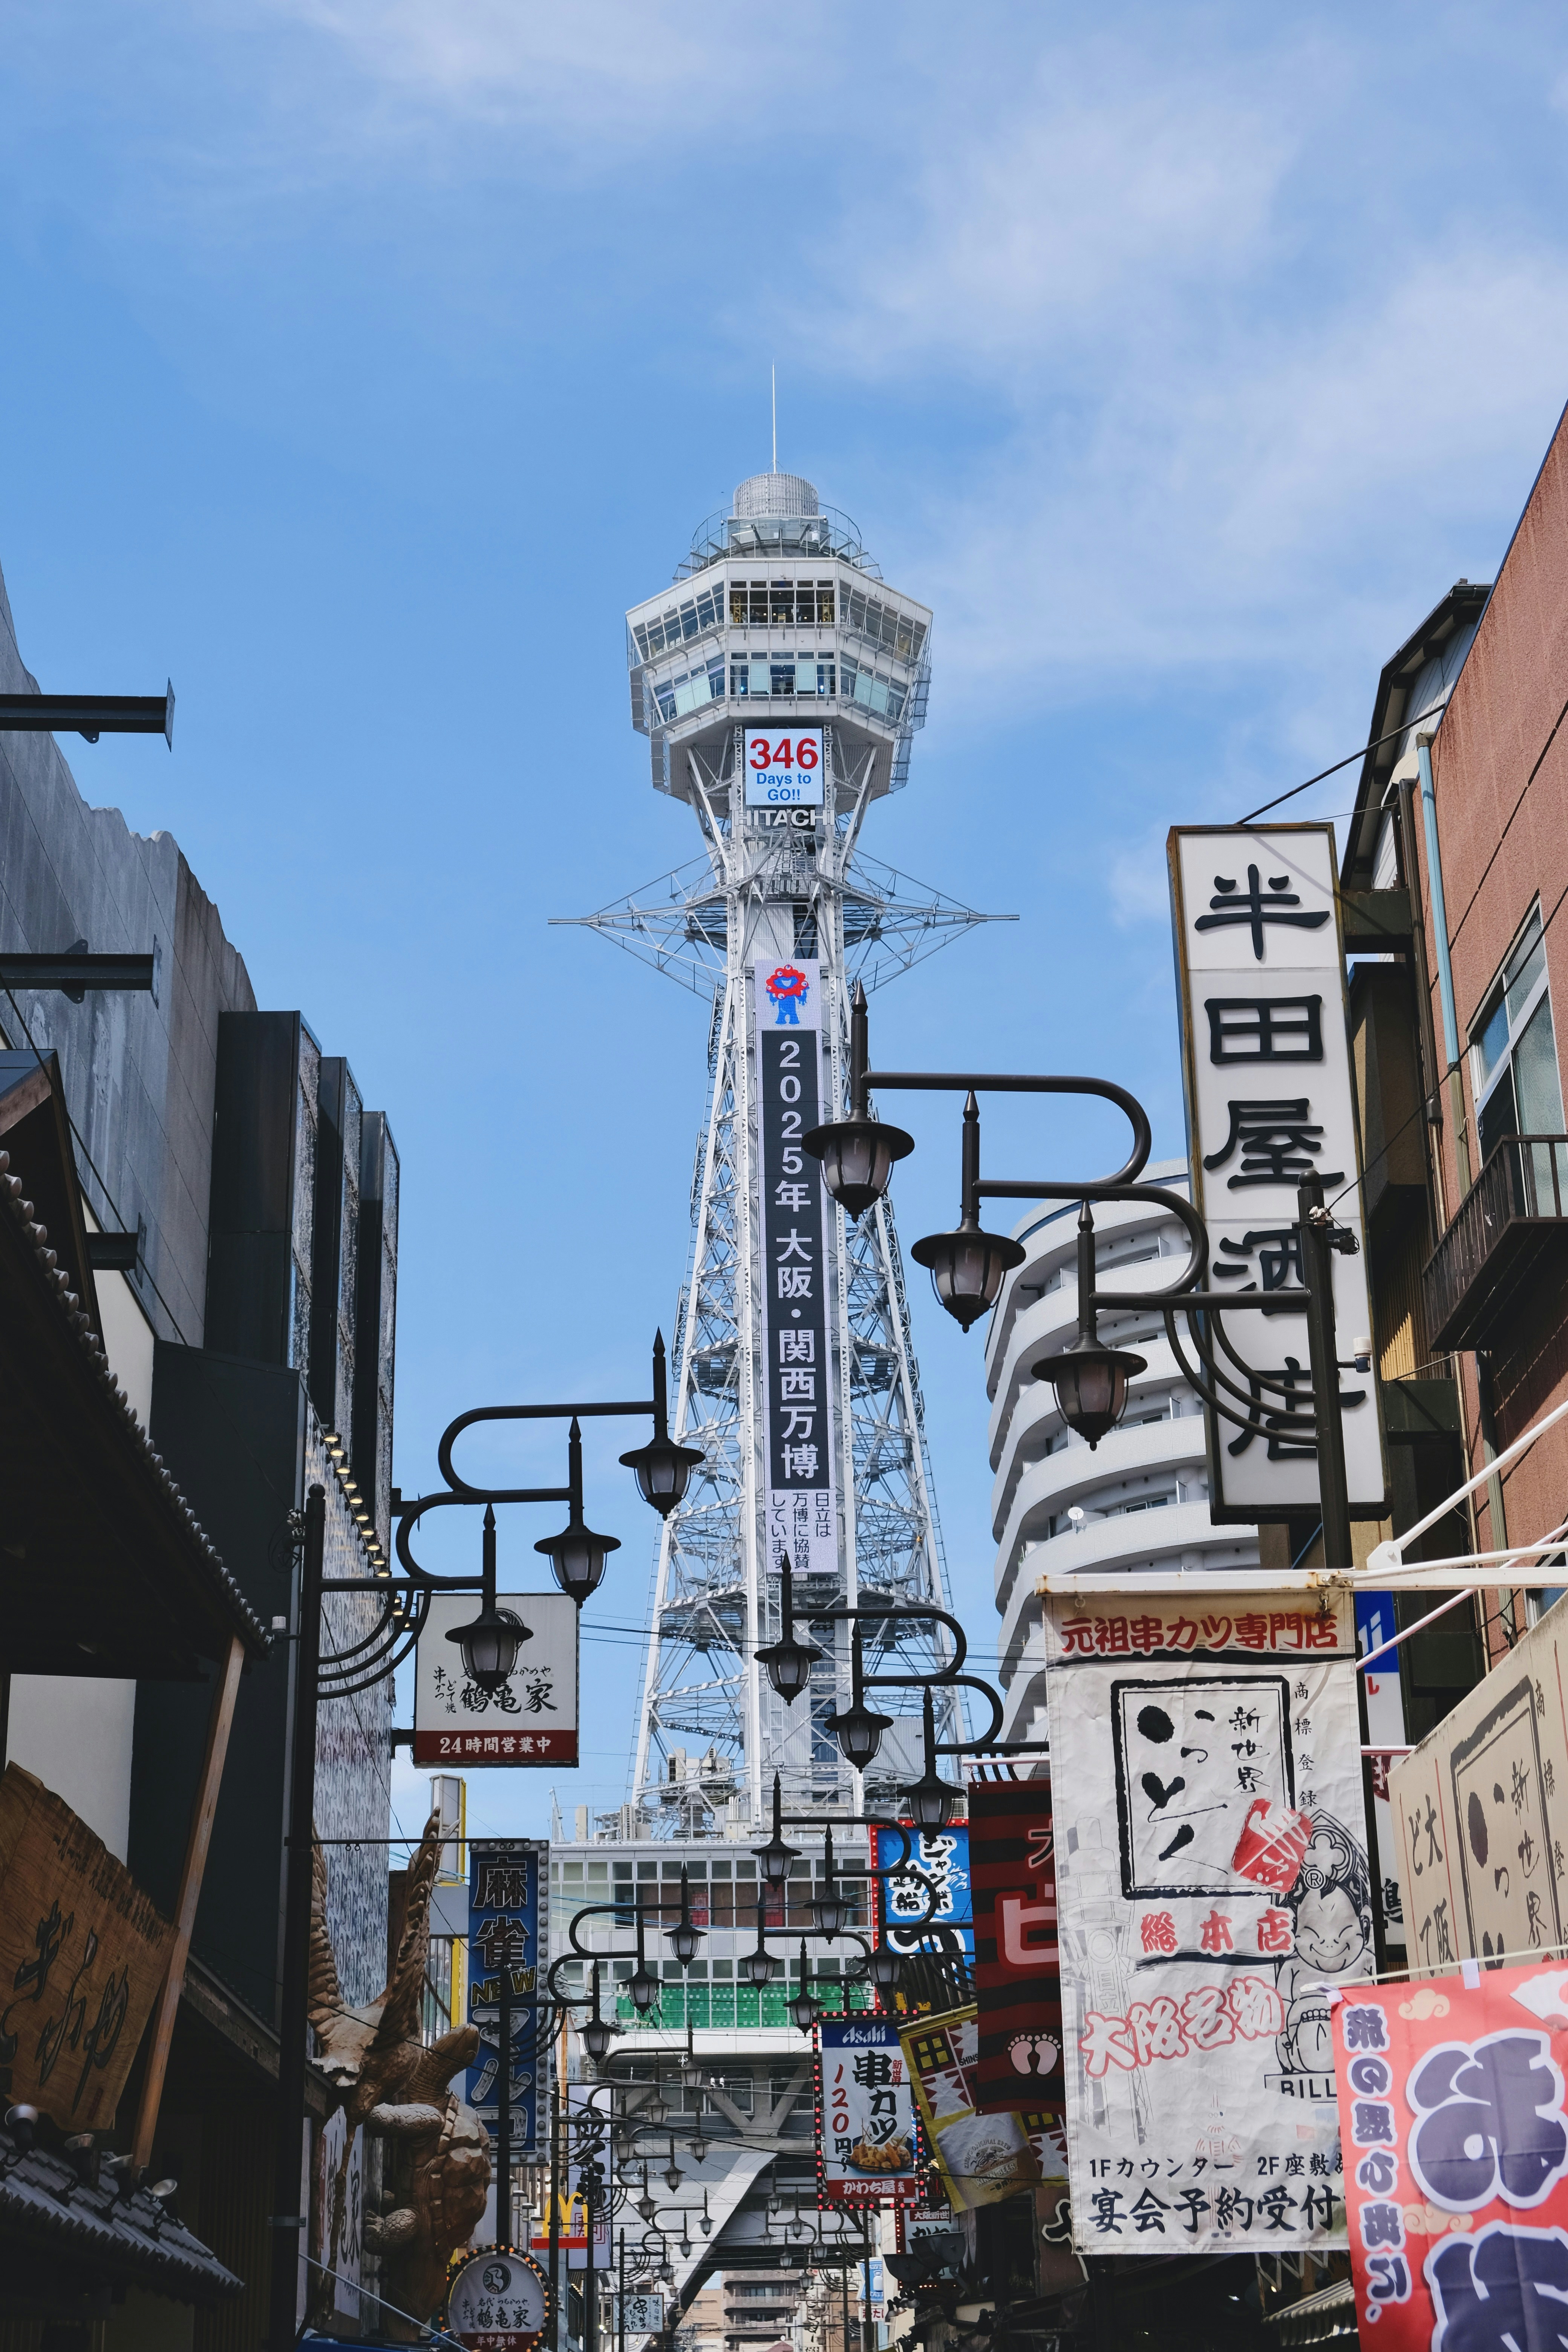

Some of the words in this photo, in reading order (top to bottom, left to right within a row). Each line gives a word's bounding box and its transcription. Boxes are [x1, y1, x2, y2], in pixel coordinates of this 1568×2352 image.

[749, 738, 818, 769] 346
[756, 772, 792, 787] Days
[797, 773, 812, 784] to
[767, 789, 800, 801] GO!!
[733, 810, 835, 826] HITACHI
[771, 1493, 787, 1569] しています
[793, 1493, 810, 1569] 万博に協賛
[815, 1493, 831, 1537] 日立は
[1061, 1612, 1338, 1653] 元祖串カツ専門店
[440, 1736, 551, 1753] 24時間営業中
[1228, 1706, 1271, 1793] 新世界
[1294, 1681, 1318, 1808] 商標登録
[472, 1856, 530, 1968] 麻雀
[1140, 1908, 1295, 1955] 総本店
[842, 2025, 886, 2044] Asahi
[1078, 1975, 1285, 2079] 大阪名物
[852, 2050, 897, 2145] 串カツ
[1089, 2157, 1234, 2180] 1Fカウンター
[842, 2180, 896, 2195] かわち屋
[476, 2306, 531, 2329] 鶴亀家
[476, 2335, 517, 2346] 年中無休
